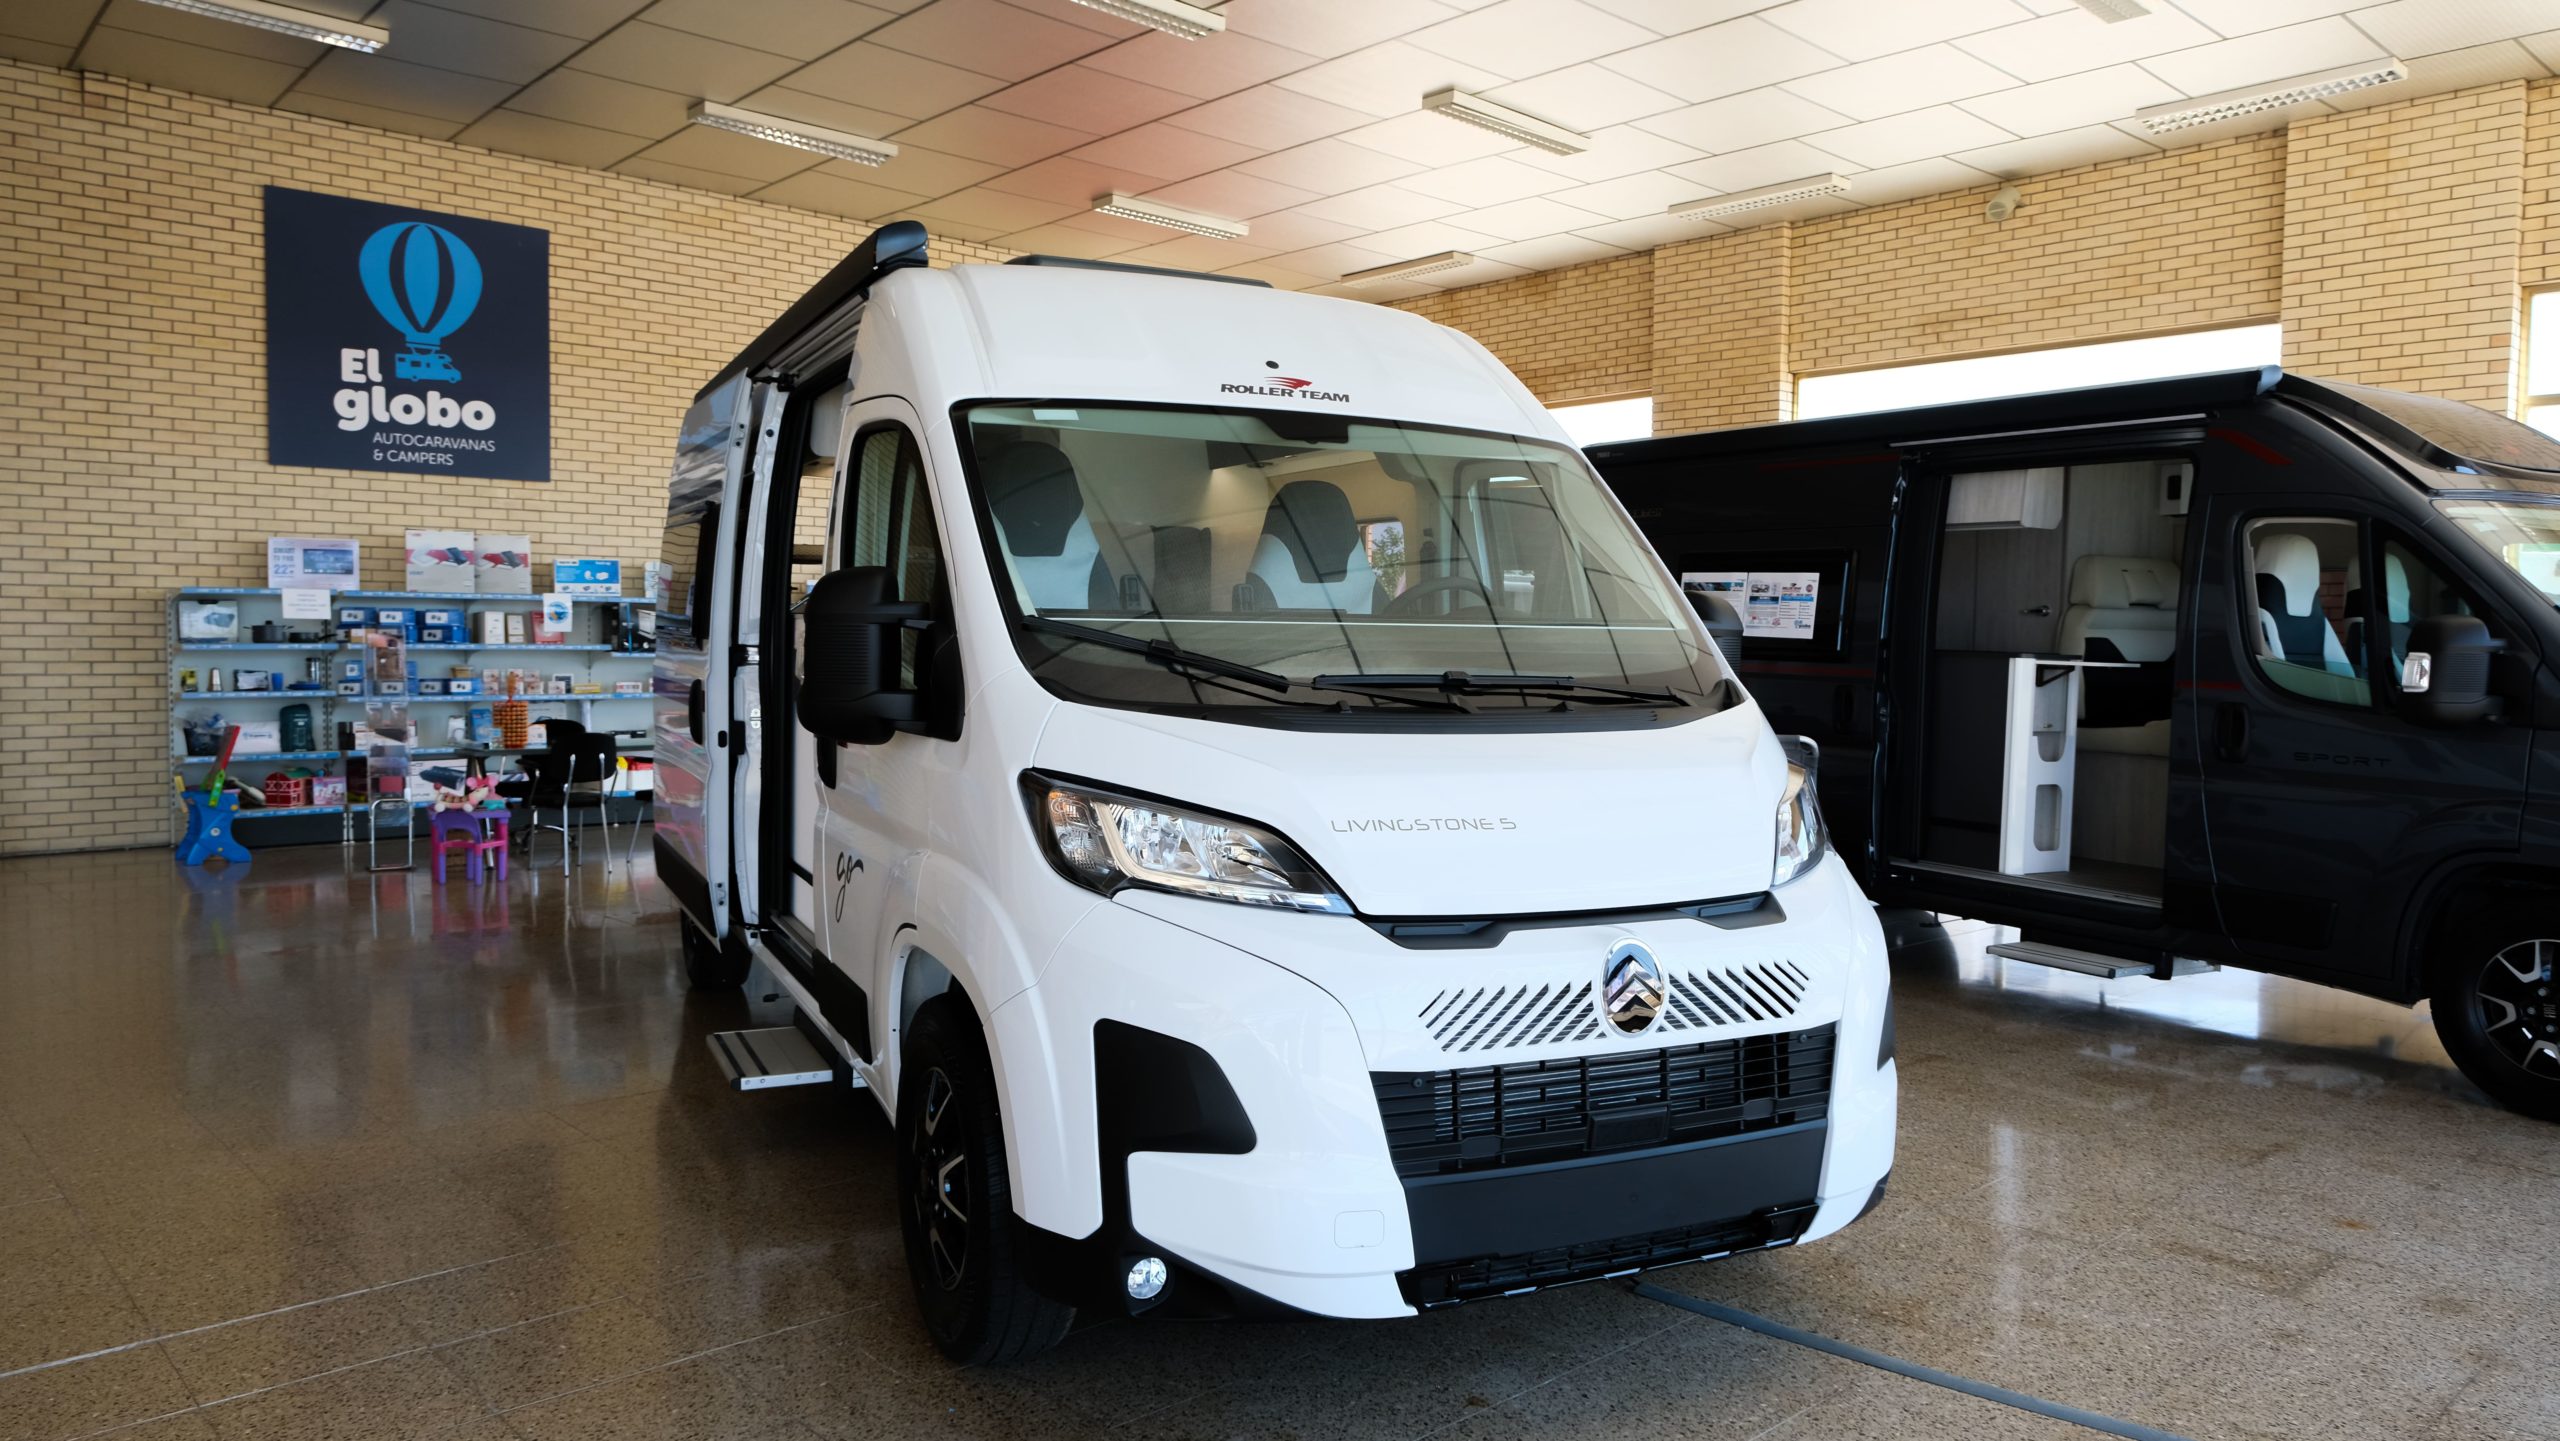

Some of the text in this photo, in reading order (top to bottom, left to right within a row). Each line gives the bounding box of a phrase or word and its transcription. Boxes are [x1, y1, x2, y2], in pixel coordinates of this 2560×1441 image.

[340, 348, 383, 383] El
[1220, 384, 1349, 402] ROLLER TEAM
[333, 385, 496, 432] globo
[372, 432, 496, 452] AUTOCARAVANAS
[372, 449, 454, 466] & CAMPERS
[2294, 752, 2392, 767] SPORT
[1330, 818, 1495, 833] LIVINGSTONE
